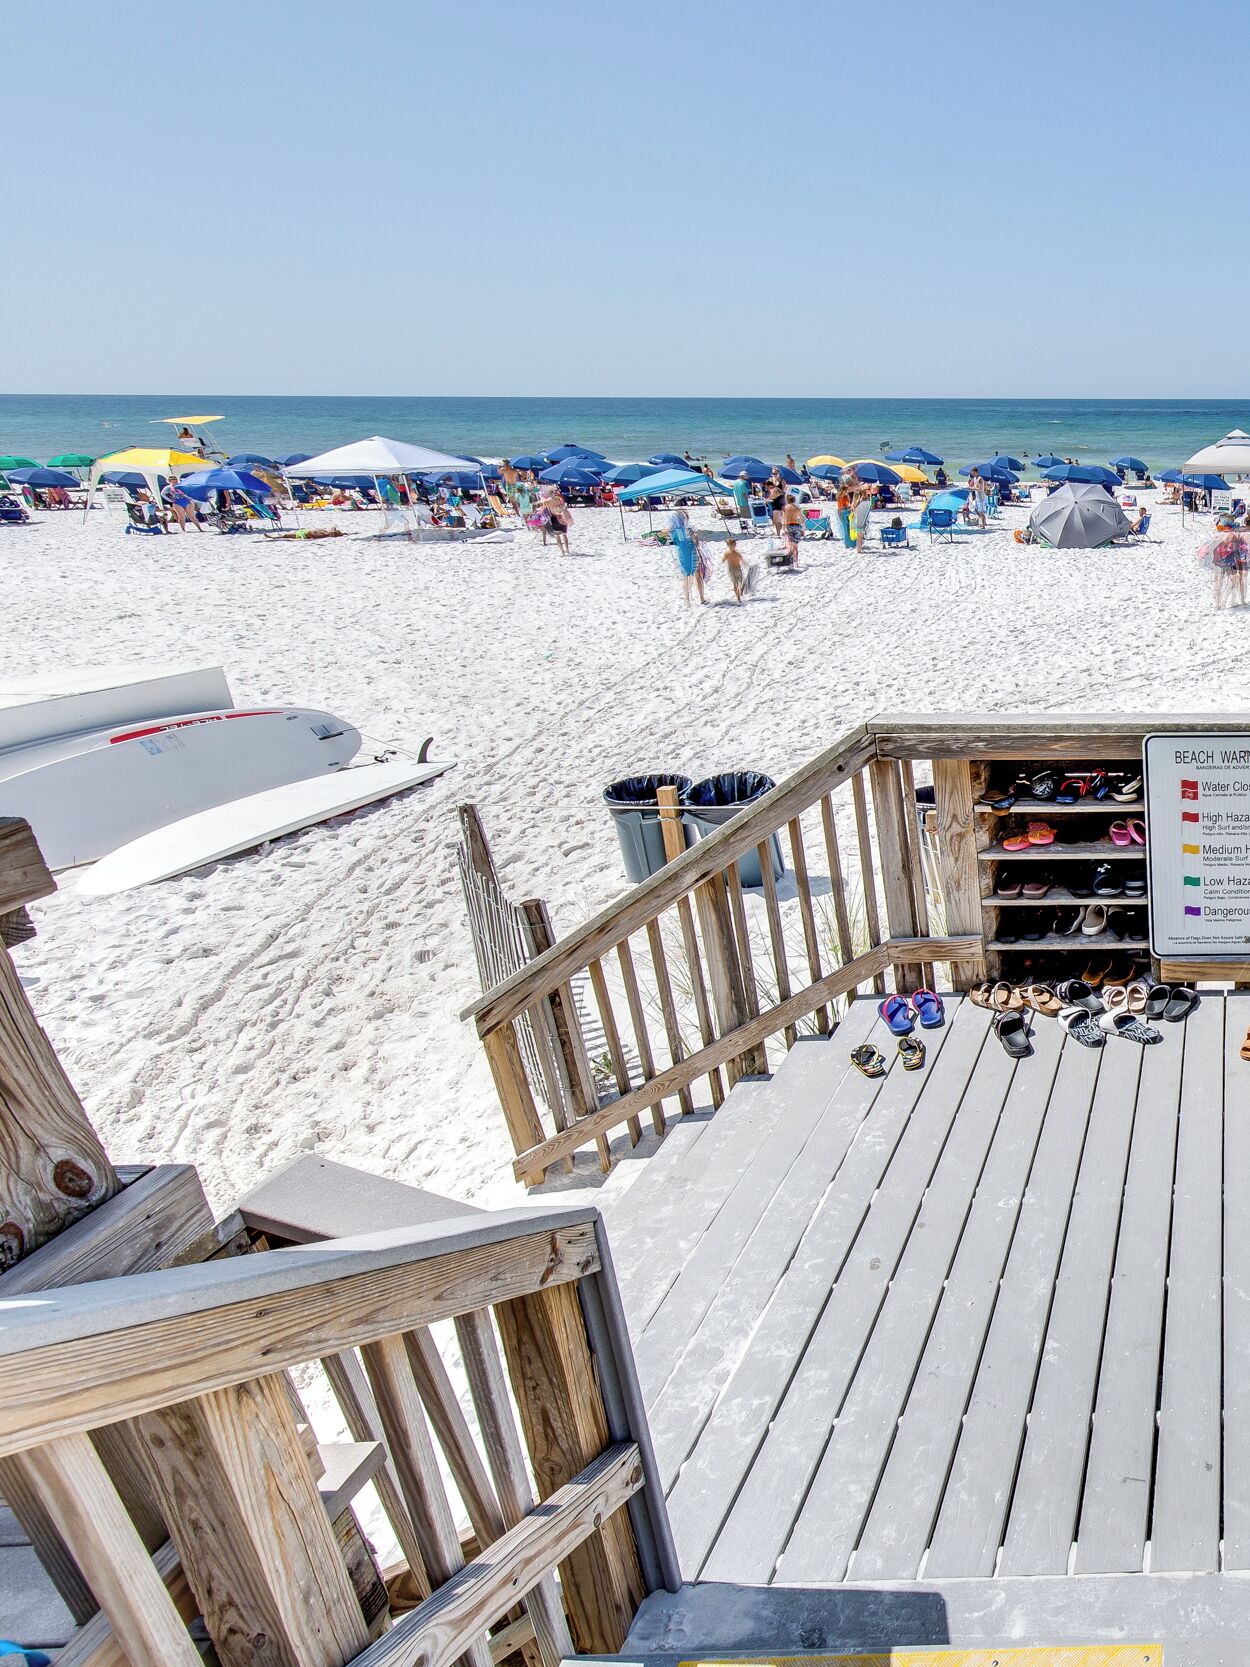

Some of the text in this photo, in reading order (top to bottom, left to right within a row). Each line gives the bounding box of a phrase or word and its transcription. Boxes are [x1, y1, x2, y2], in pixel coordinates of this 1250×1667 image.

[1175, 750, 1214, 764] BEACH
[1202, 782, 1230, 792] Water
[1202, 812, 1222, 824] High
[1202, 844, 1242, 854] Medium
[1203, 876, 1224, 886] Low
